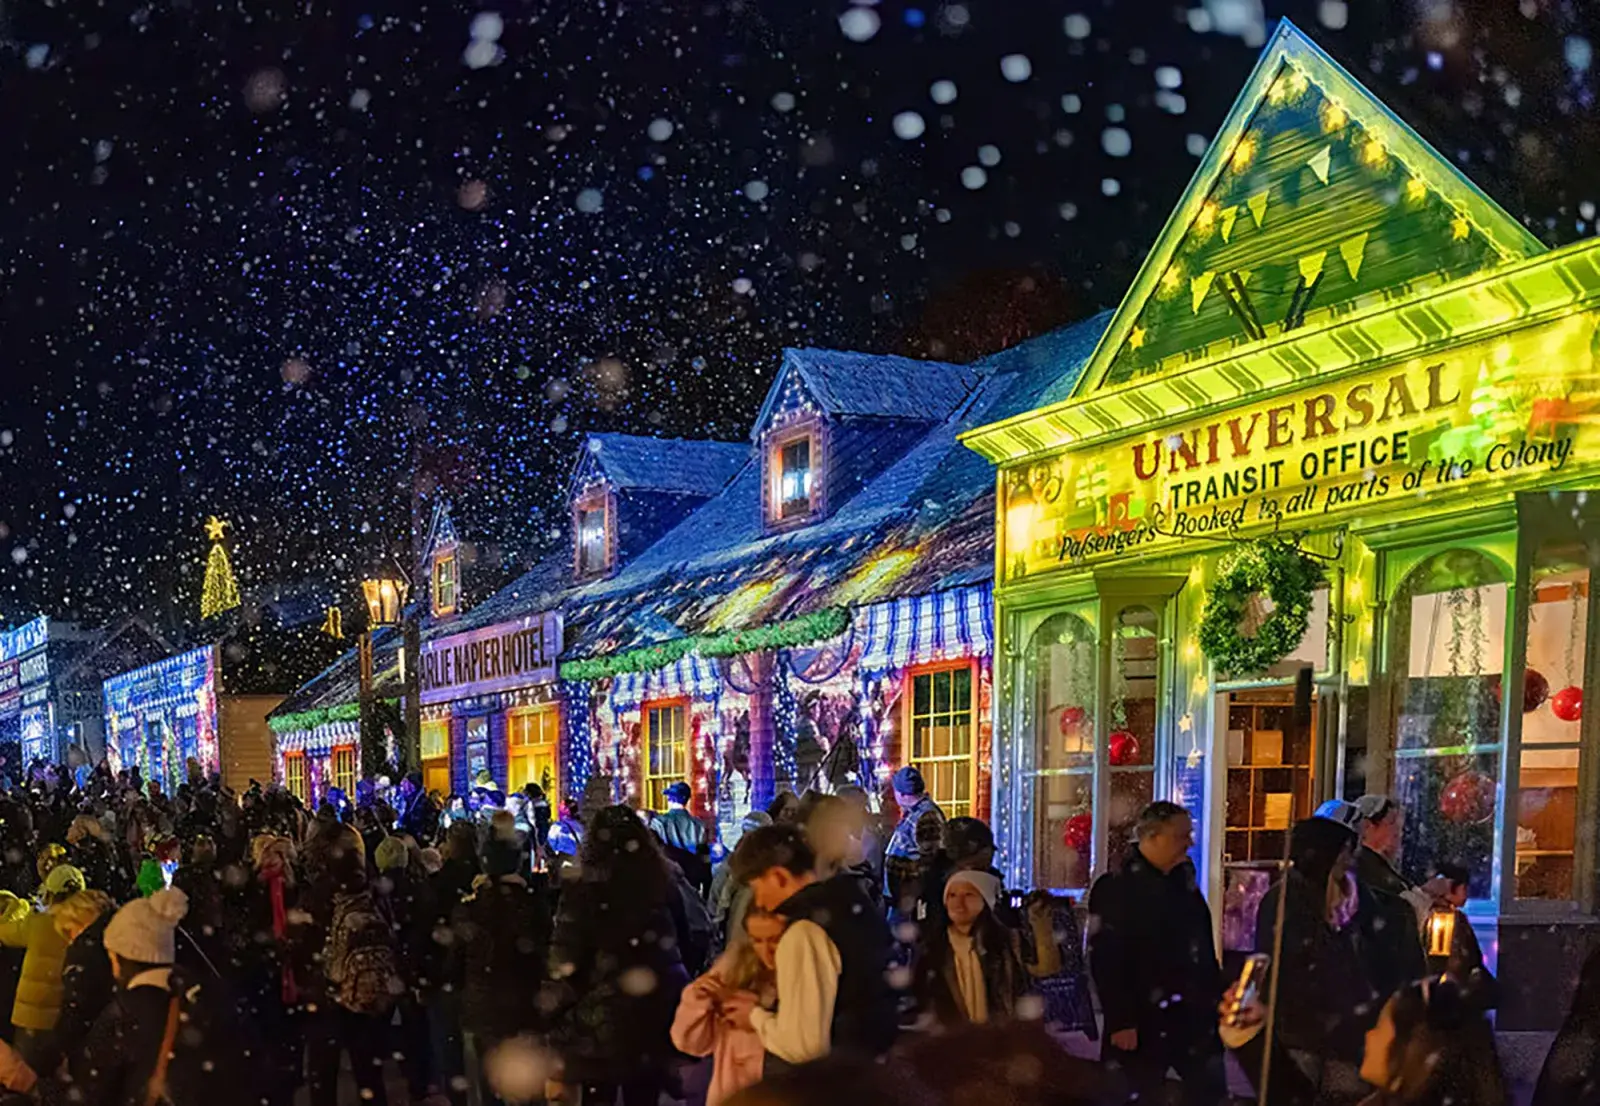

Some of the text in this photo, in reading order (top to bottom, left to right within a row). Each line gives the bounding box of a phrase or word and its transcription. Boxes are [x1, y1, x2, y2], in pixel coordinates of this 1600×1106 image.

[1132, 361, 1461, 481] UNIVERSAL
[1170, 430, 1409, 510] TRANSIT OFFICE
[1172, 499, 1248, 537] Booked
[1285, 484, 1318, 514] all
[1325, 471, 1390, 513] parts
[1402, 459, 1433, 491] of
[1436, 455, 1473, 484] the
[454, 636, 501, 684] NAPIER
